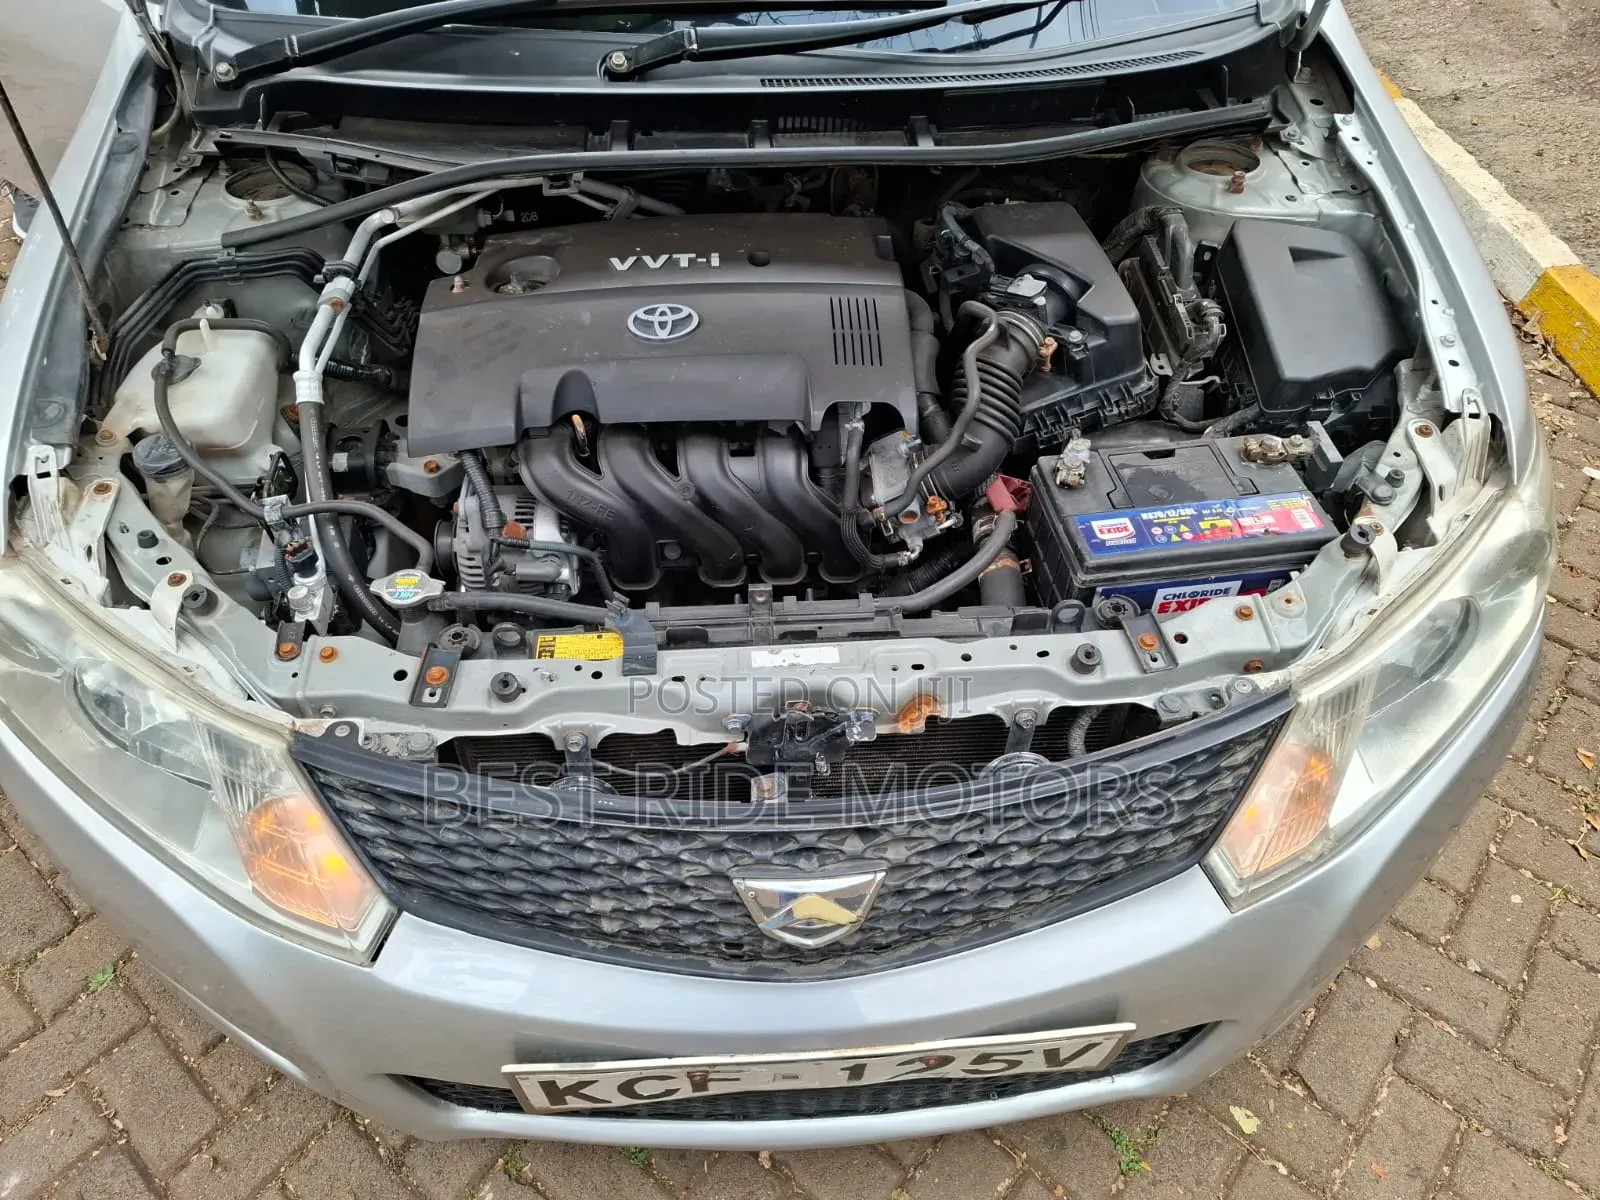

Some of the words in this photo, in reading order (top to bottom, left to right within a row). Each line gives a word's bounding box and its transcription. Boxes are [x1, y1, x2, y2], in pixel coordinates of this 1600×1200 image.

[1098, 525, 1131, 535] EXIDE
[1162, 587, 1232, 601] CHLORIDE
[1157, 597, 1213, 614] EXI
